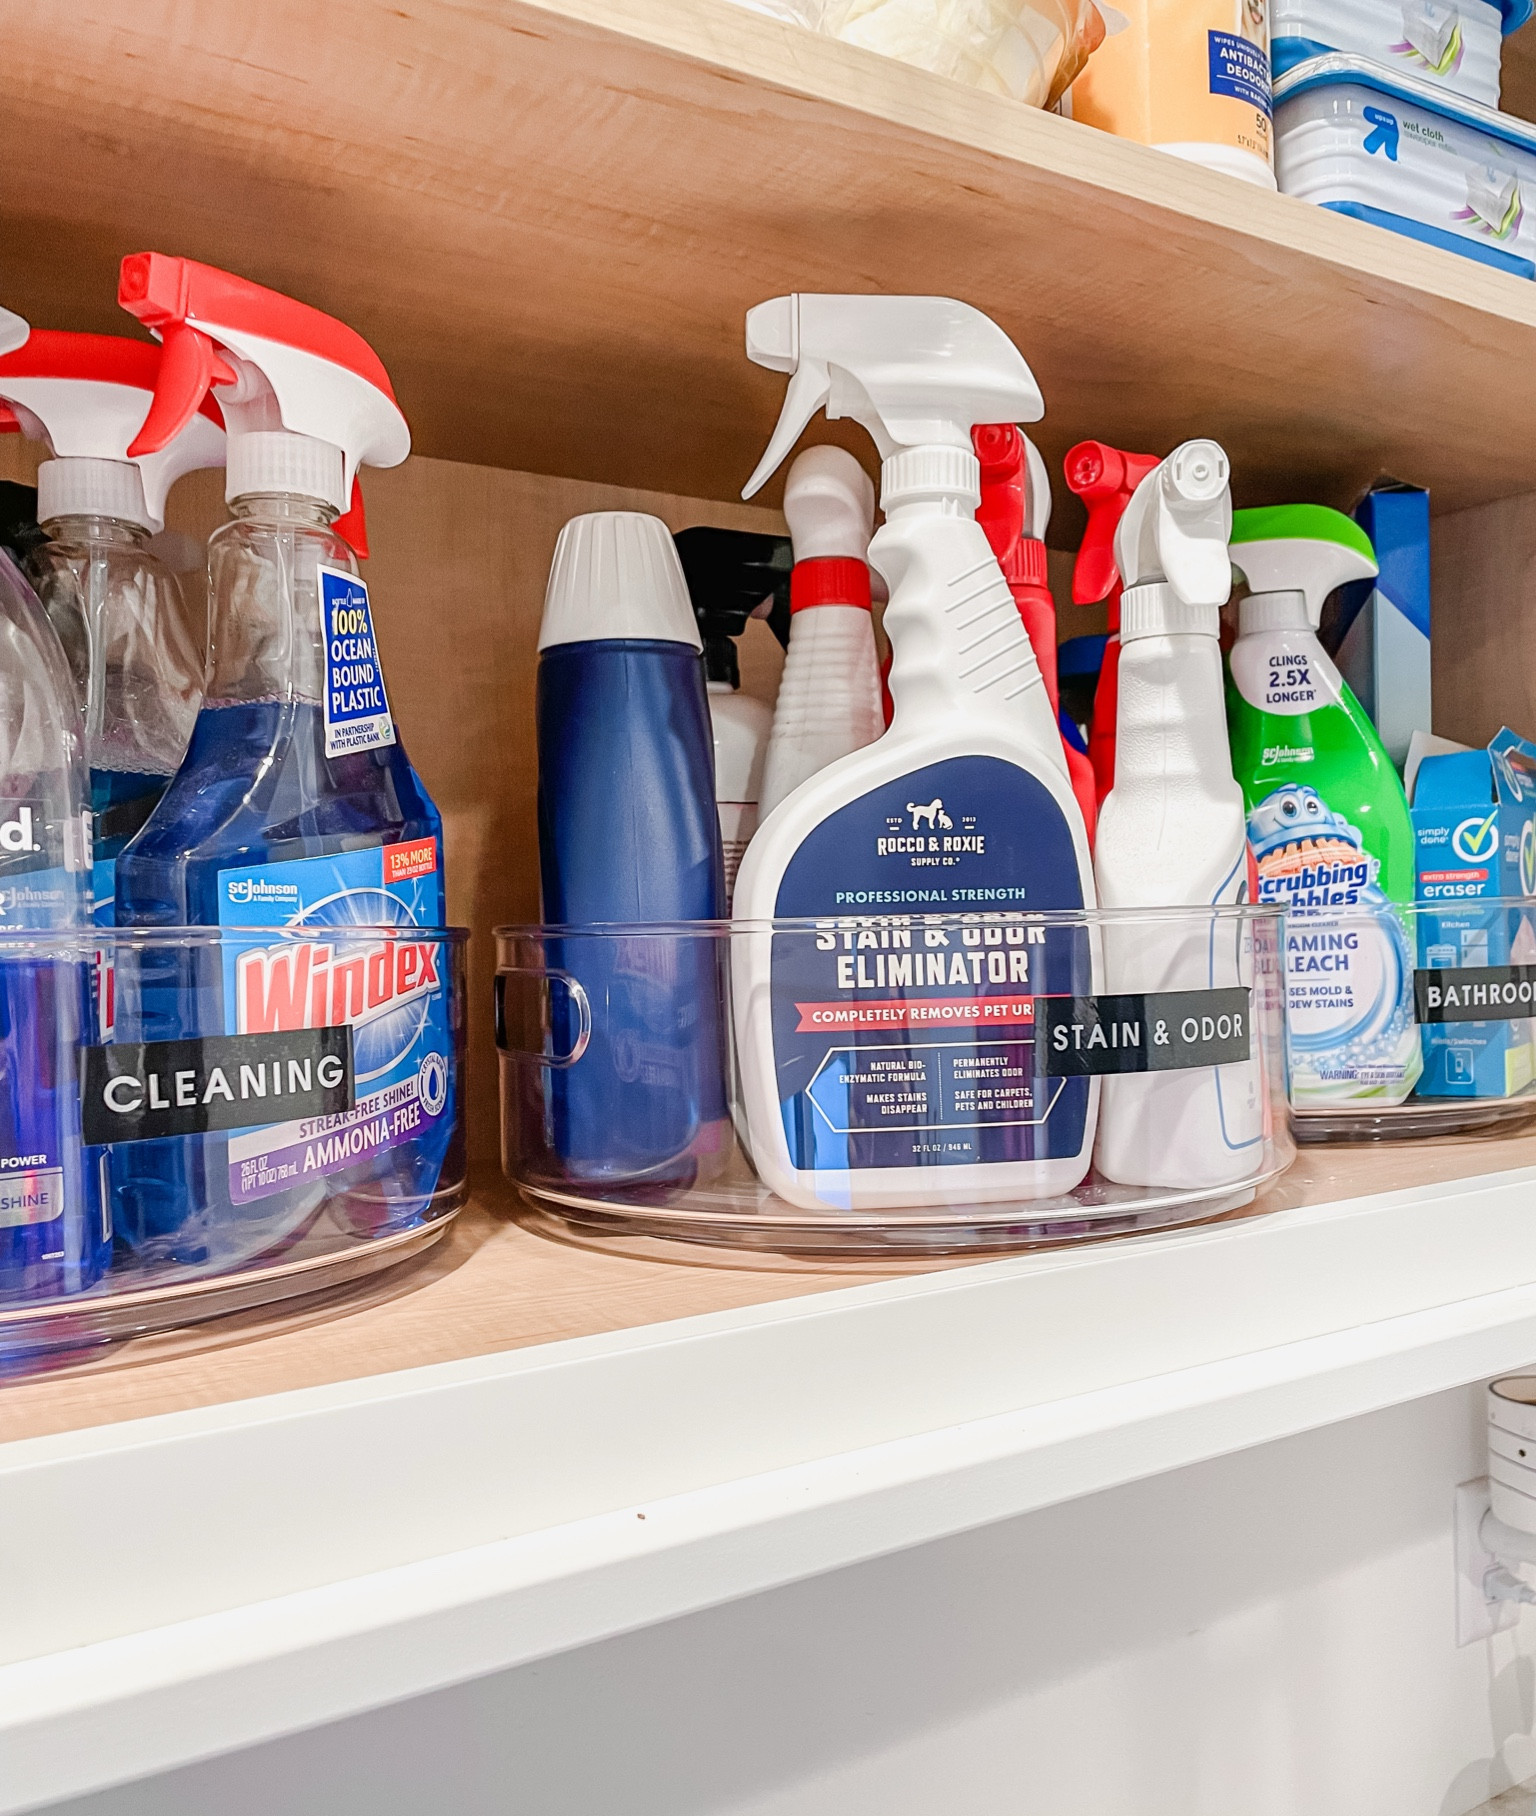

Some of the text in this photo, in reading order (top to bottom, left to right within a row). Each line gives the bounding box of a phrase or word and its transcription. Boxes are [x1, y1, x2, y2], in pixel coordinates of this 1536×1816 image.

[1256, 113, 1267, 132] 50
[1402, 120, 1444, 142] wet cloth
[331, 609, 368, 636] 100%
[331, 638, 372, 662] OCEAN
[1269, 654, 1308, 668] CLINGS
[332, 663, 374, 688] BOUND
[1269, 668, 1312, 688] 2.5X
[332, 686, 382, 714] PLASTIC
[334, 722, 374, 739] IN PARTNERSHIP
[330, 732, 380, 750] WITH PLASTIC BANK
[1418, 827, 1450, 836] simply
[878, 836, 985, 856] ROCCO & ROXIE
[390, 848, 432, 869] 13% MORE
[910, 857, 940, 867] SUPPLY
[1258, 862, 1368, 895] Scrubbing
[836, 887, 1026, 904] PROFESSIONAL STRENGTH
[1424, 884, 1486, 898] eraser
[1288, 932, 1358, 952] AMING
[837, 950, 1028, 989] ELIMINATOR
[1288, 954, 1349, 972] LEACH
[245, 941, 437, 1034] Windex
[1289, 986, 1353, 996] SES MOLD &
[1289, 998, 1312, 1008] DEW
[1315, 998, 1354, 1008] STAINS
[812, 1008, 906, 1024] COMPLETELY
[910, 1005, 980, 1020] REMOVES
[984, 1004, 1008, 1017] PET
[1053, 1014, 1243, 1052] STAIN & ODOR
[870, 1060, 926, 1070] NATURAL BIO-
[953, 1056, 1008, 1068] PERMANENTLY
[839, 1072, 926, 1084] ENZYMATIC FORMULA
[954, 1068, 1023, 1079] ELIMINATES ODOR
[103, 1054, 344, 1113] CLEANING
[866, 1092, 927, 1104] MAKES STAINS
[954, 1090, 976, 1100] SAFE
[978, 1089, 992, 1098] FOR
[300, 1081, 414, 1139] STREAK-FREE SHINE!
[882, 1104, 928, 1114] DISAPPEAR
[955, 1099, 1033, 1111] PETS AND CHILDREN
[303, 1101, 421, 1173] AMMONIA-FREE
[923, 1144, 931, 1152] FL
[932, 1144, 941, 1152] OZ
[963, 1142, 972, 1150] ML
[1, 1154, 48, 1169] POWER
[241, 1155, 268, 1177] 26 FL OZ
